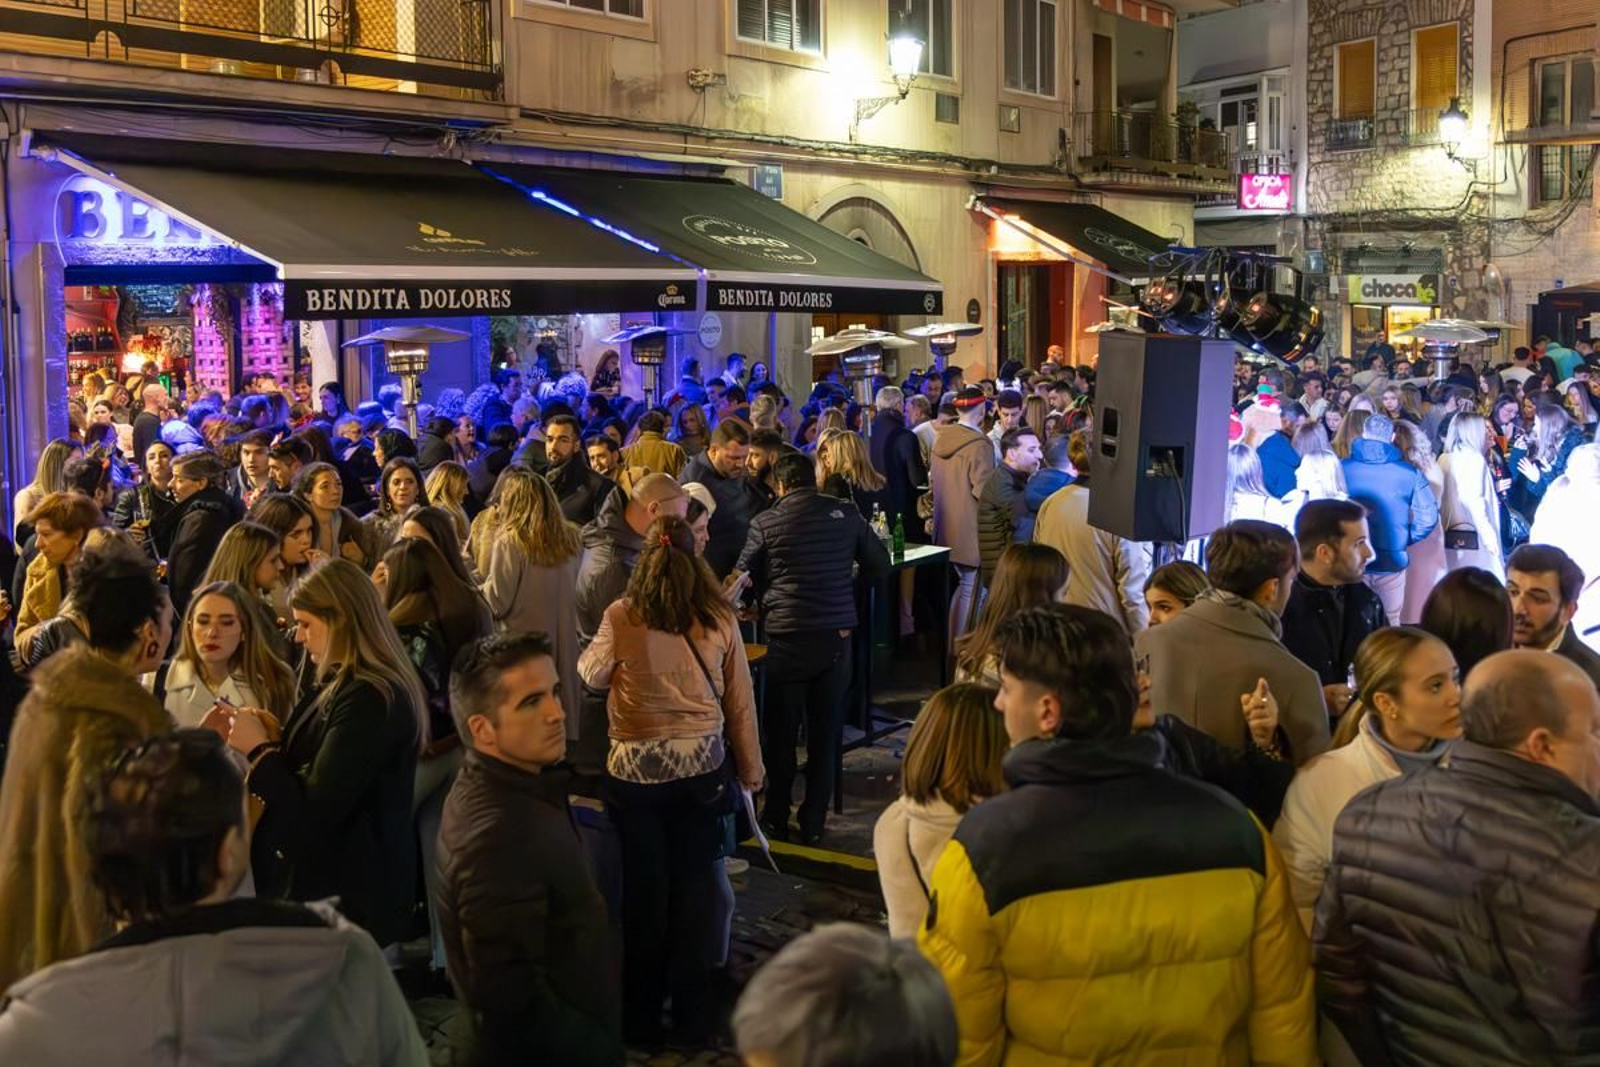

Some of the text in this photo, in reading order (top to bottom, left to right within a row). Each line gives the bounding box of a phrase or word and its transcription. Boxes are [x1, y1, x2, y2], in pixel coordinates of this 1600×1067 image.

[307, 288, 511, 311] BENDITA DOLORES
[658, 294, 686, 308] Corona
[719, 289, 832, 308] BENDITA DOLORES
